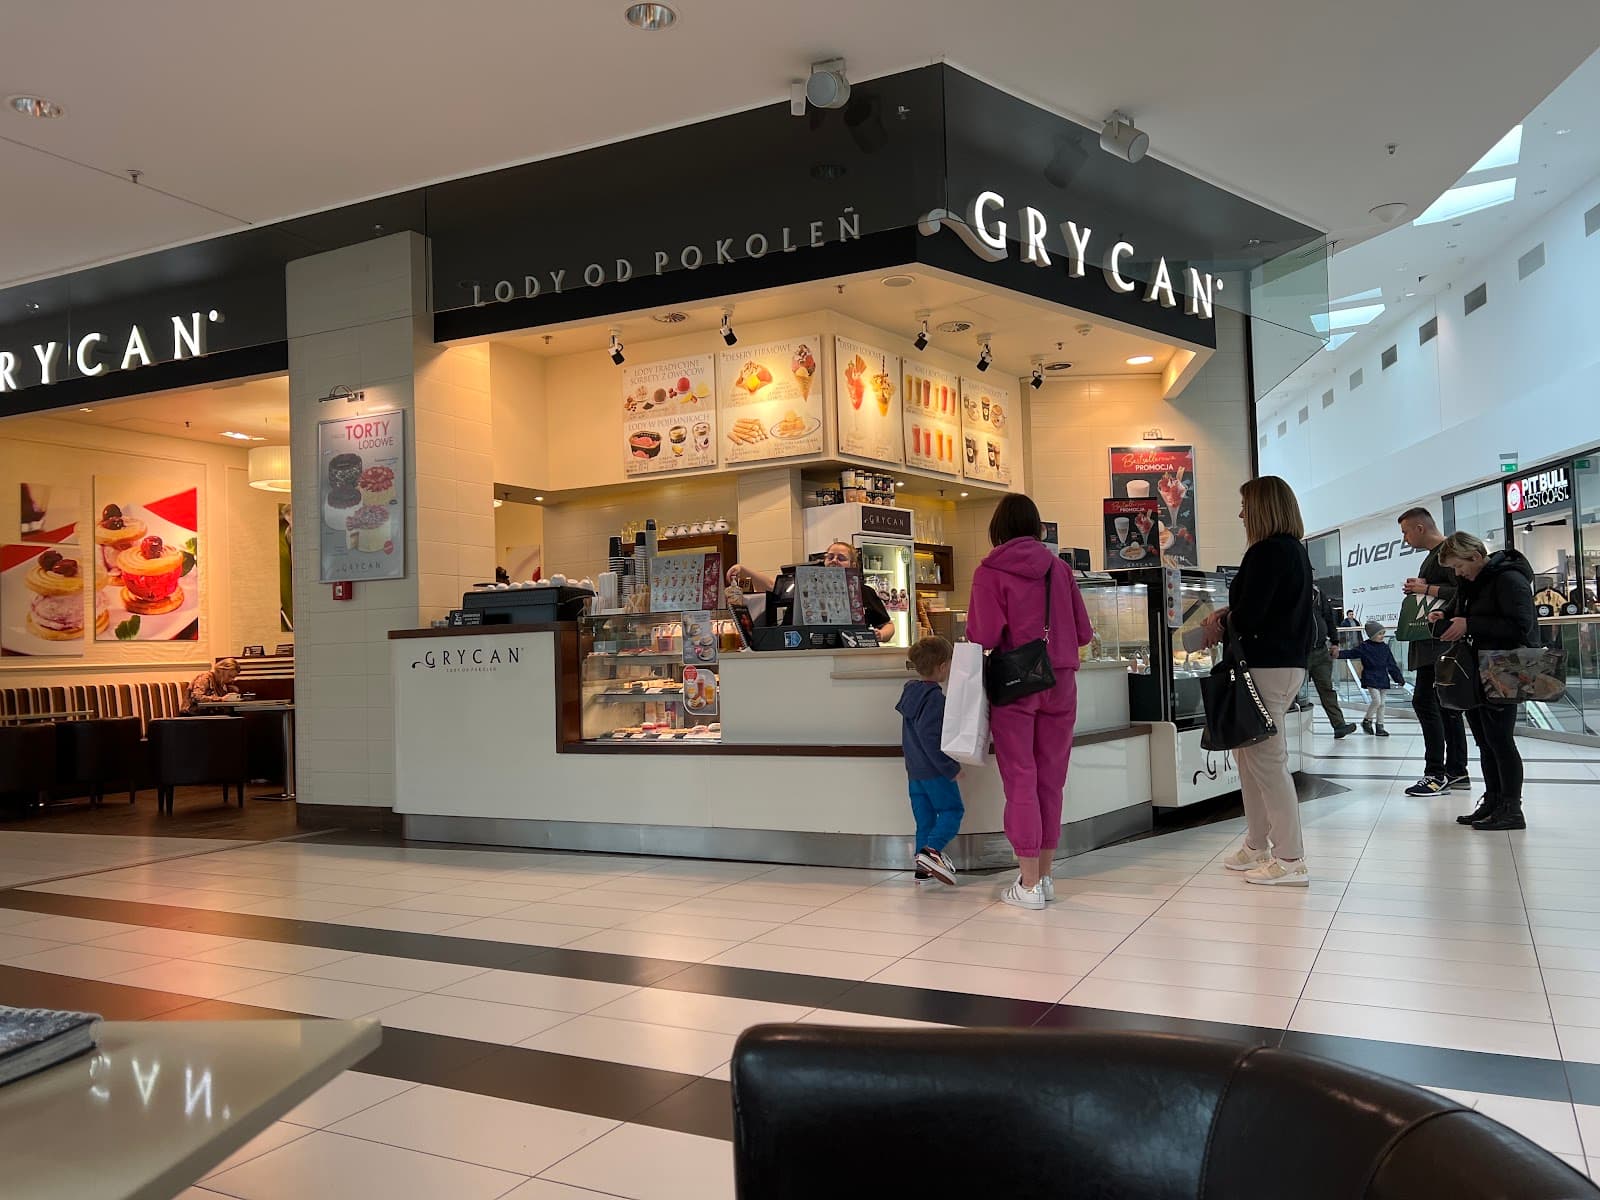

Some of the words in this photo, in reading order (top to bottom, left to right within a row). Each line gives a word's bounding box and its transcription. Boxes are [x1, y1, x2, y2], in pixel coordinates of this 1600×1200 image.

[966, 191, 1213, 319] GRYCAN
[473, 269, 566, 307] LODY
[583, 259, 633, 287] OD
[345, 421, 390, 441] TORTY
[358, 437, 394, 450] LODOWE
[1521, 475, 1538, 496] PIT
[1539, 468, 1569, 492] BULL
[868, 514, 905, 527] GRYCAN
[1347, 539, 1432, 567] divers
[424, 647, 519, 668] GRYCAN
